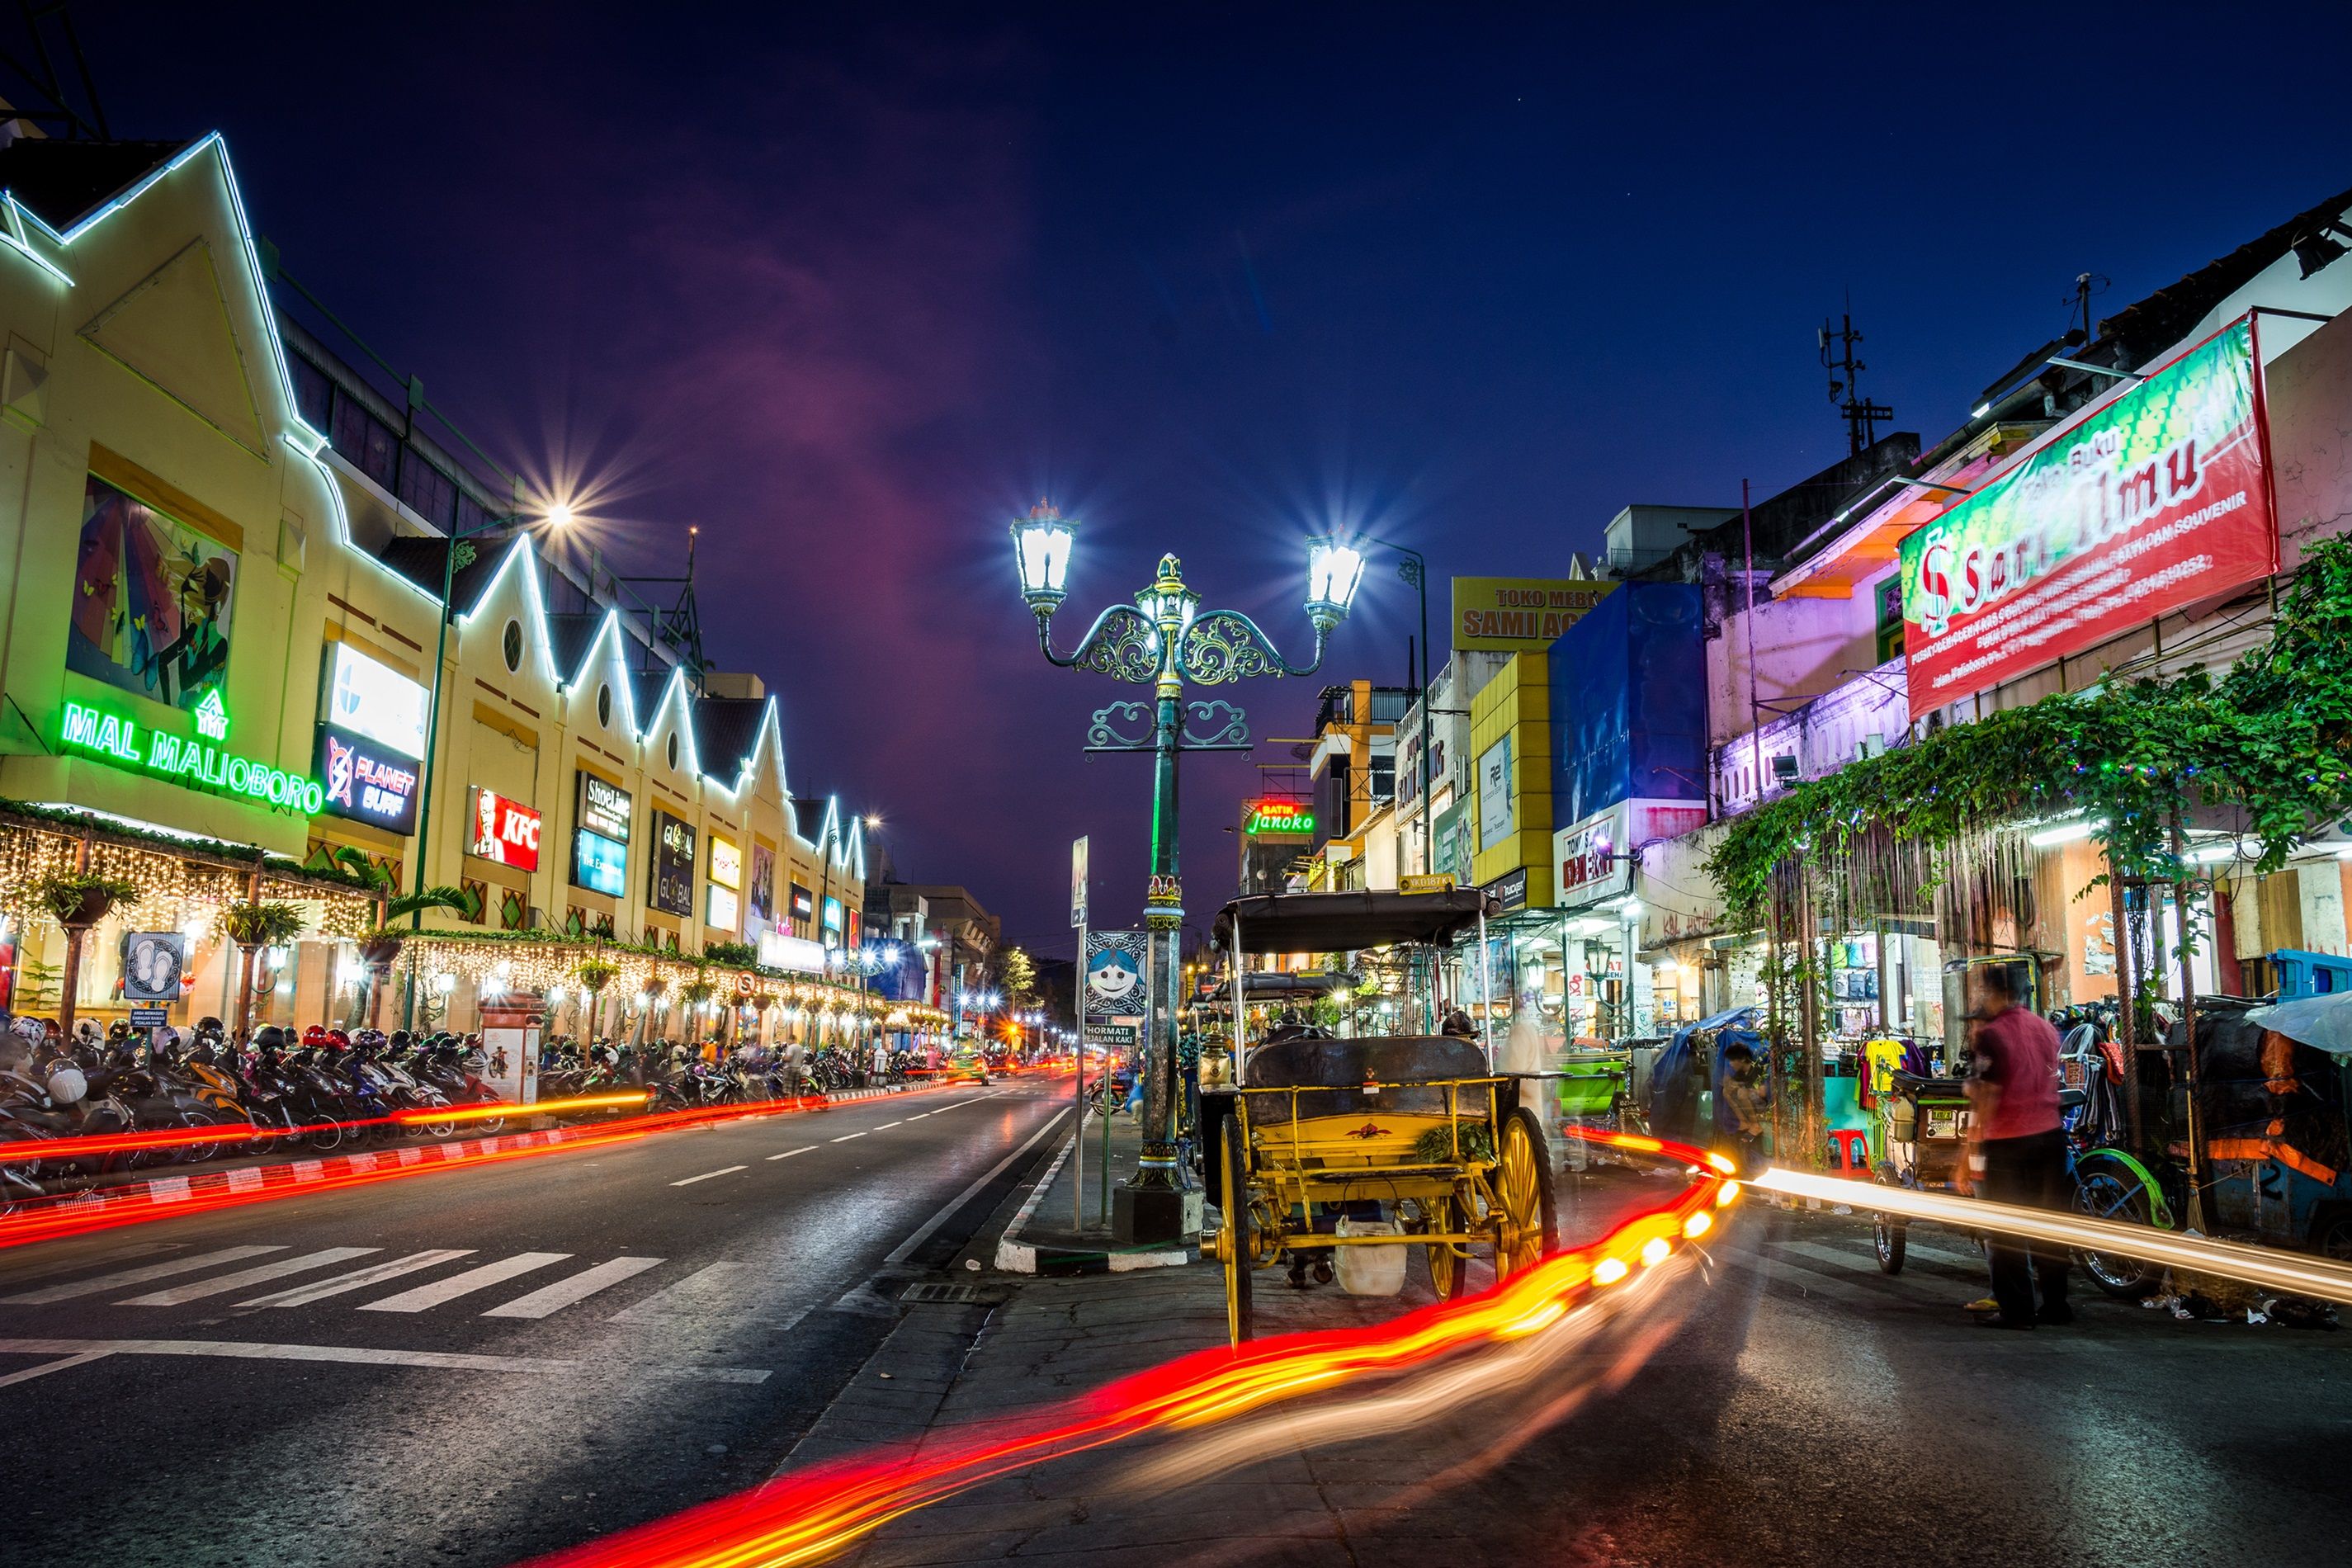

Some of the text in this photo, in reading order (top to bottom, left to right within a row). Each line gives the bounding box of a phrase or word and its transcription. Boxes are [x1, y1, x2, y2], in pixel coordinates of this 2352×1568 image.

[2175, 490, 2247, 534] SOUVENIR
[1495, 588, 1604, 608] TOKO MEB
[1462, 609, 1587, 640] SAMI AG
[63, 702, 323, 814] MAL MALIOBORO
[355, 755, 415, 797] PLANET
[363, 786, 404, 817] SURF
[1263, 805, 1293, 814] BATIK
[502, 809, 541, 850] KFC
[1249, 812, 1312, 833] Janoko
[1567, 833, 1584, 856] TOK
[1084, 1035, 1113, 1043] PEJALAN
[1087, 1026, 1129, 1035] HORMATI
